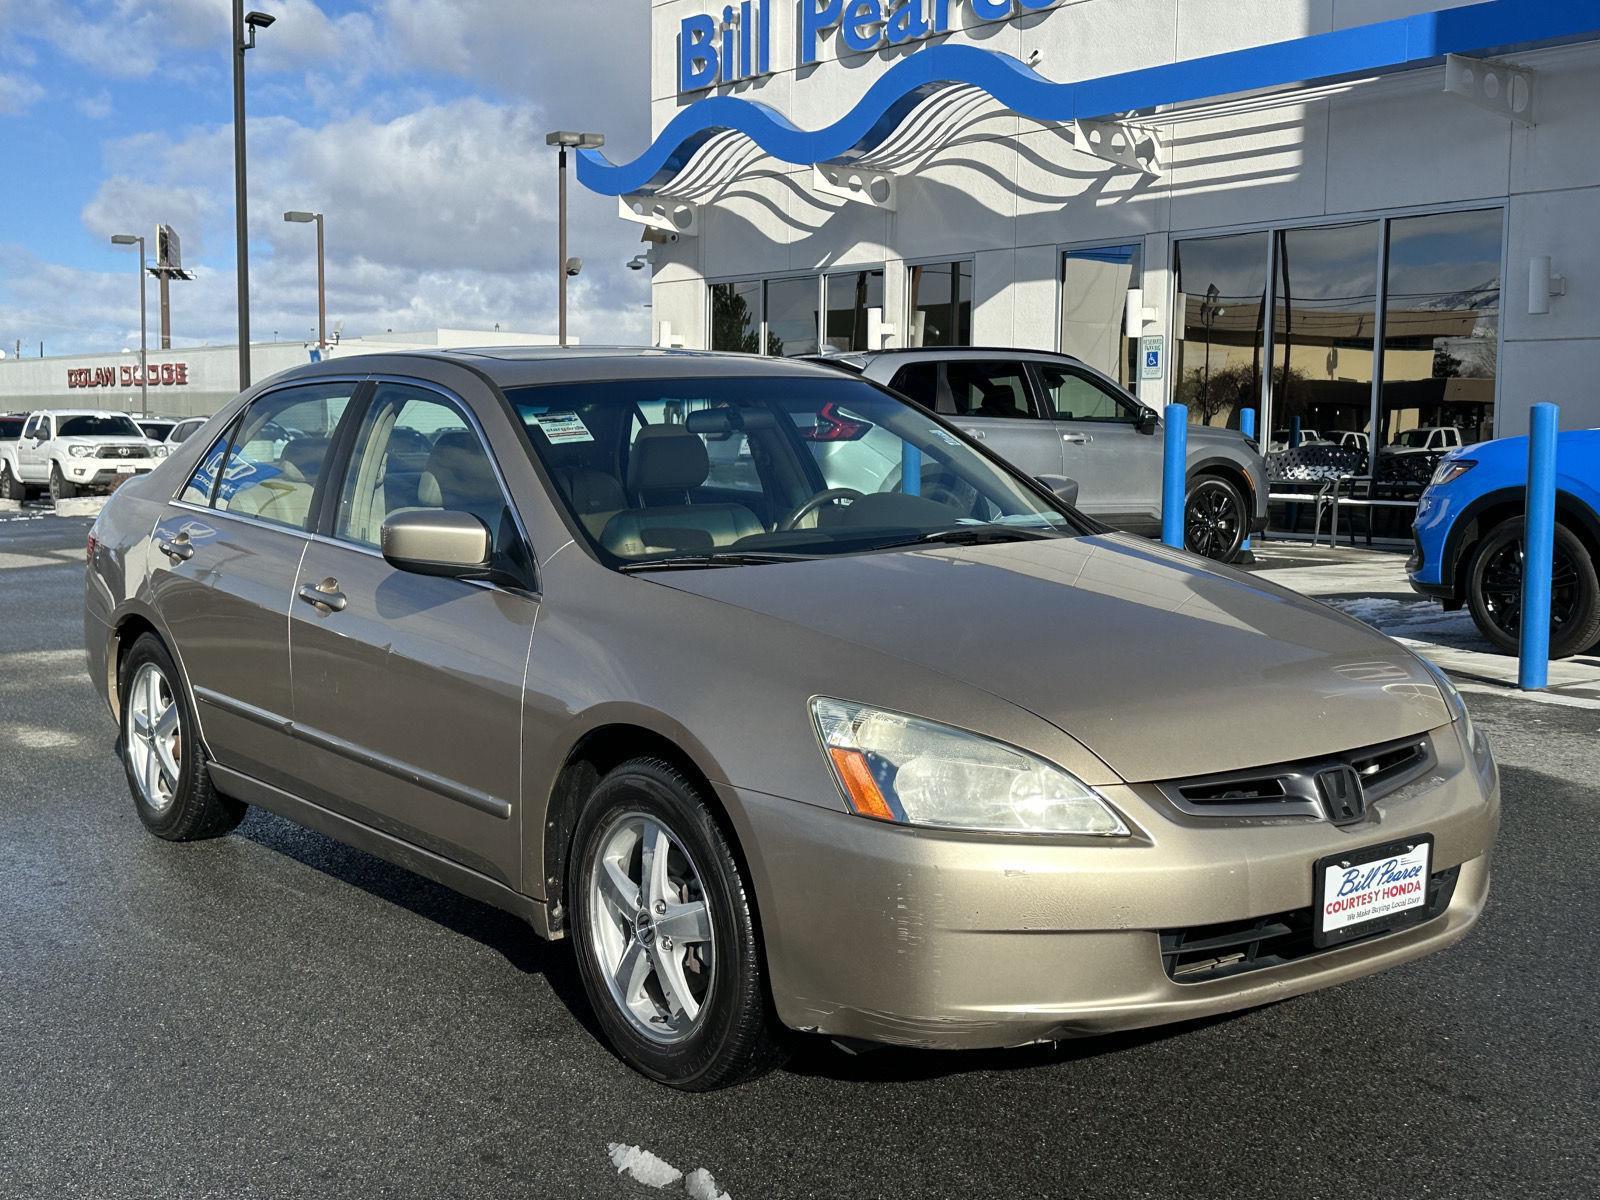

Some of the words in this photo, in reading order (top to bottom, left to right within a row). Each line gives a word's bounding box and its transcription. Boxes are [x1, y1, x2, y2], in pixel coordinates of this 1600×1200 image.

[680, 0, 771, 92] Bill
[67, 367, 115, 388] DOLAN
[1337, 866, 1380, 897] Bill
[1377, 859, 1422, 885] Pearce
[1326, 890, 1380, 914] COURTESY
[1382, 880, 1421, 899] HONDA
[1347, 913, 1355, 921] We
[1356, 909, 1370, 918] Make
[1371, 904, 1390, 914] Buying
[1391, 899, 1406, 908] Local
[1407, 896, 1420, 905] Easy
